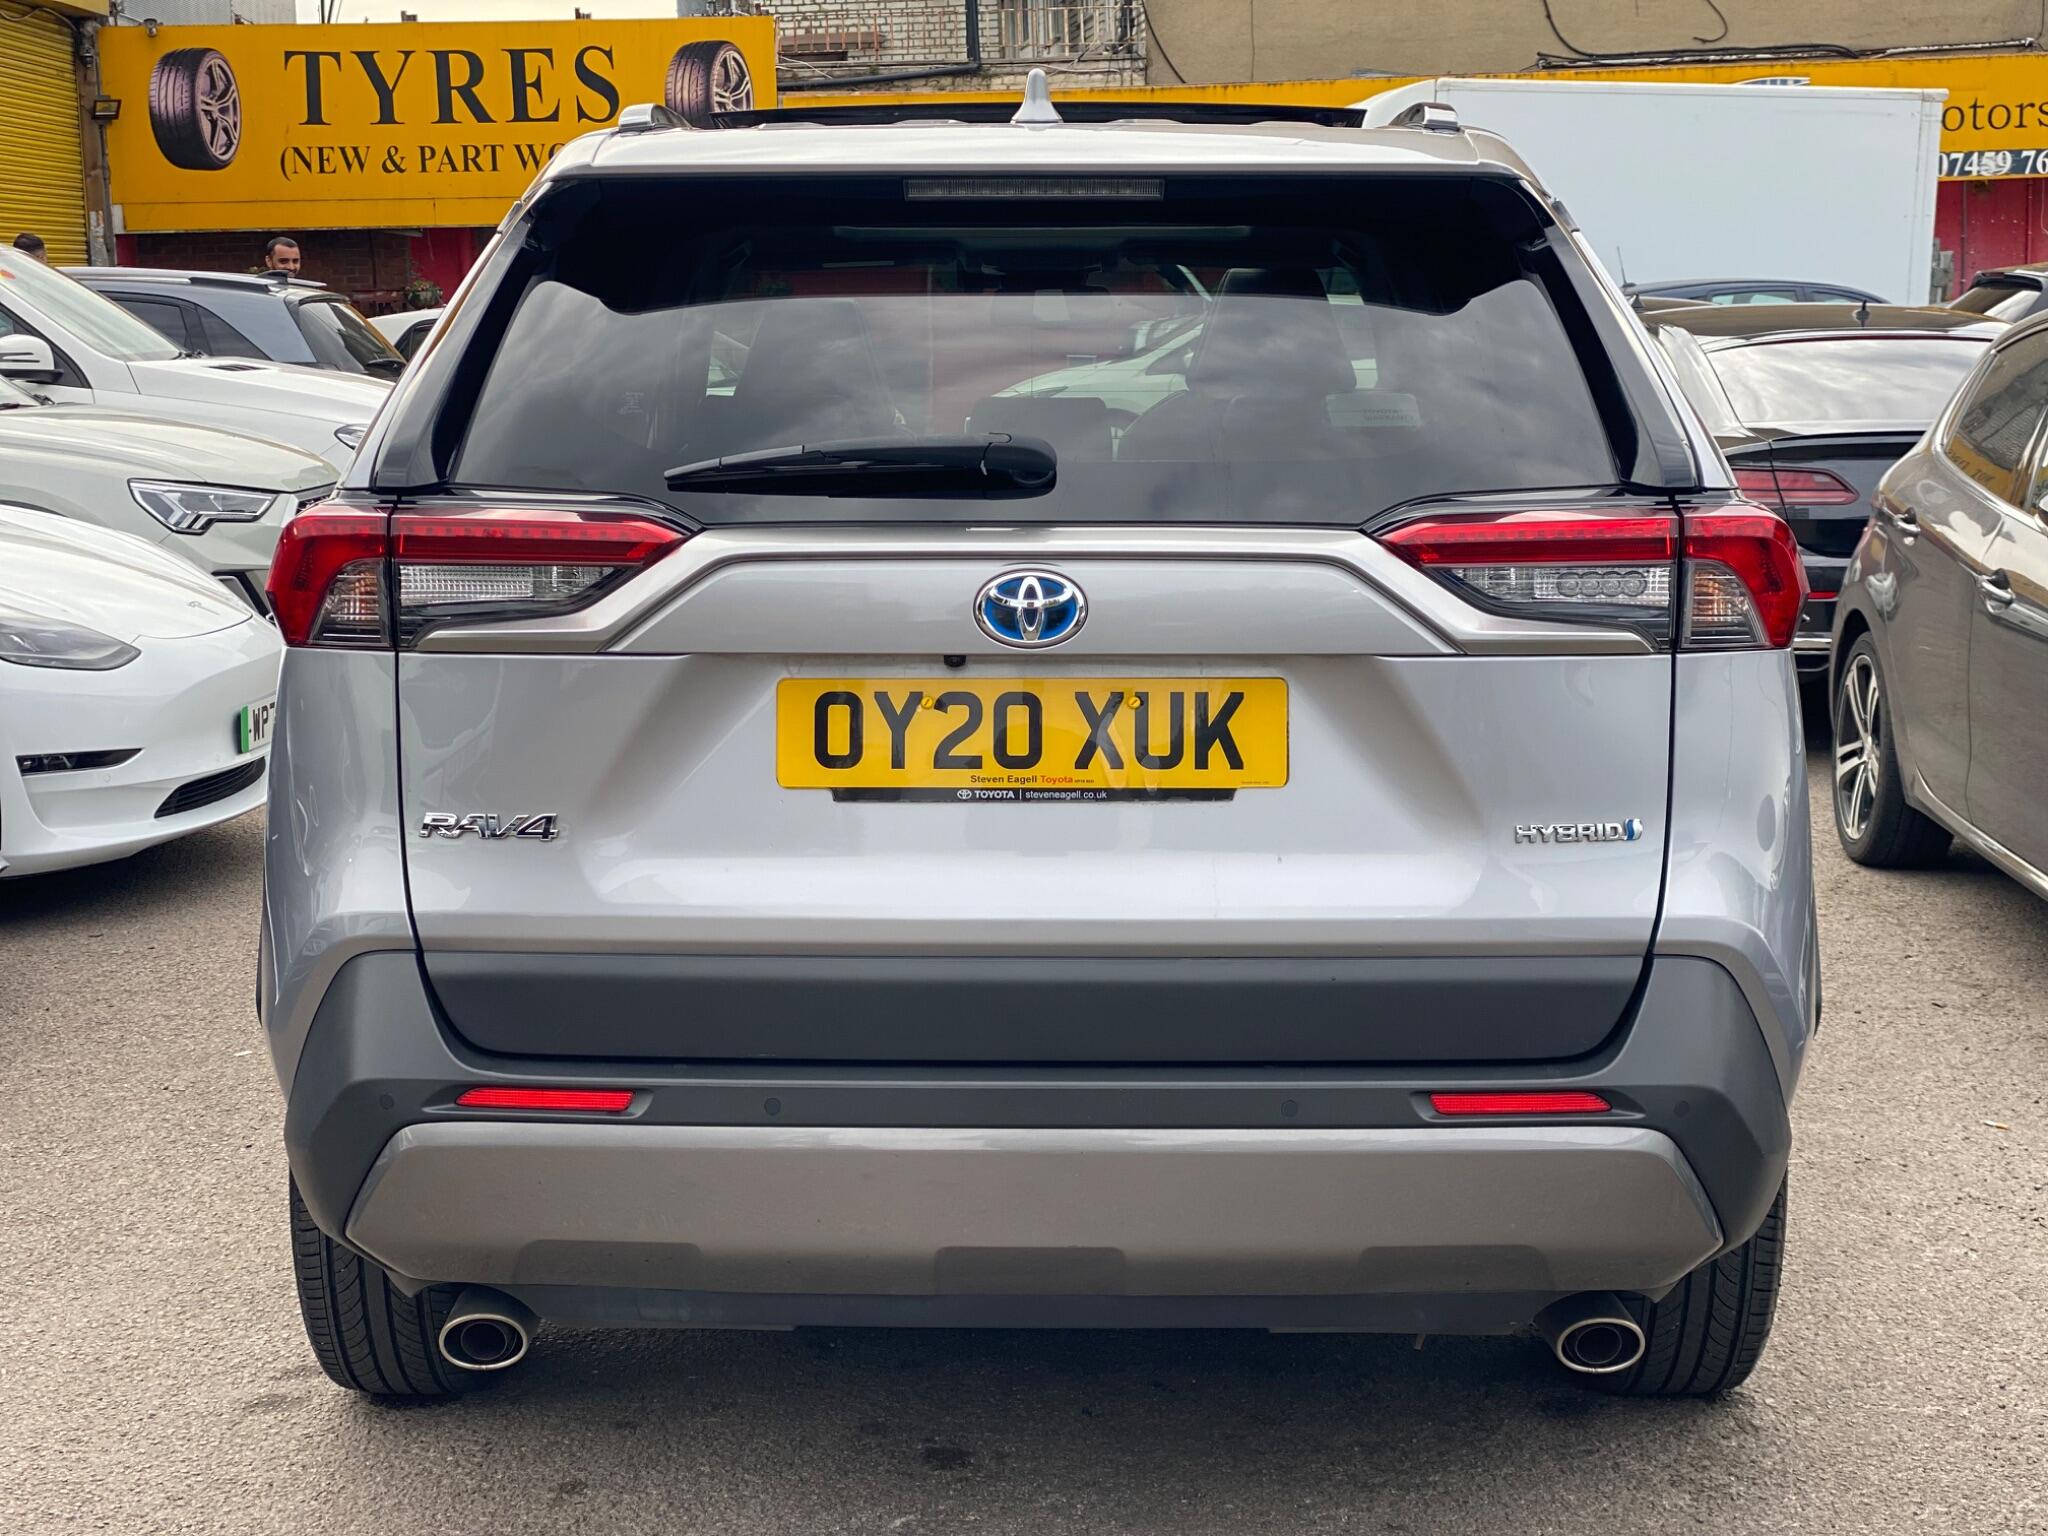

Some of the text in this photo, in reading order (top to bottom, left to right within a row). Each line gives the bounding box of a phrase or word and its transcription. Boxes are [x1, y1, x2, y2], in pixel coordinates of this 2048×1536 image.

[284, 45, 620, 126] TYRES
[280, 145, 370, 182] (NEW
[381, 144, 407, 174] &
[418, 143, 504, 173] PART
[813, 690, 1245, 770] OY20 XUK
[970, 774, 1005, 784] Steven
[1007, 774, 1038, 785] Eagell
[1040, 774, 1073, 785] Toyota
[974, 789, 1108, 800] TOYOTA steveneagell.co.uk
[419, 811, 559, 842] RAV4
[1515, 822, 1625, 844] HYBRID
